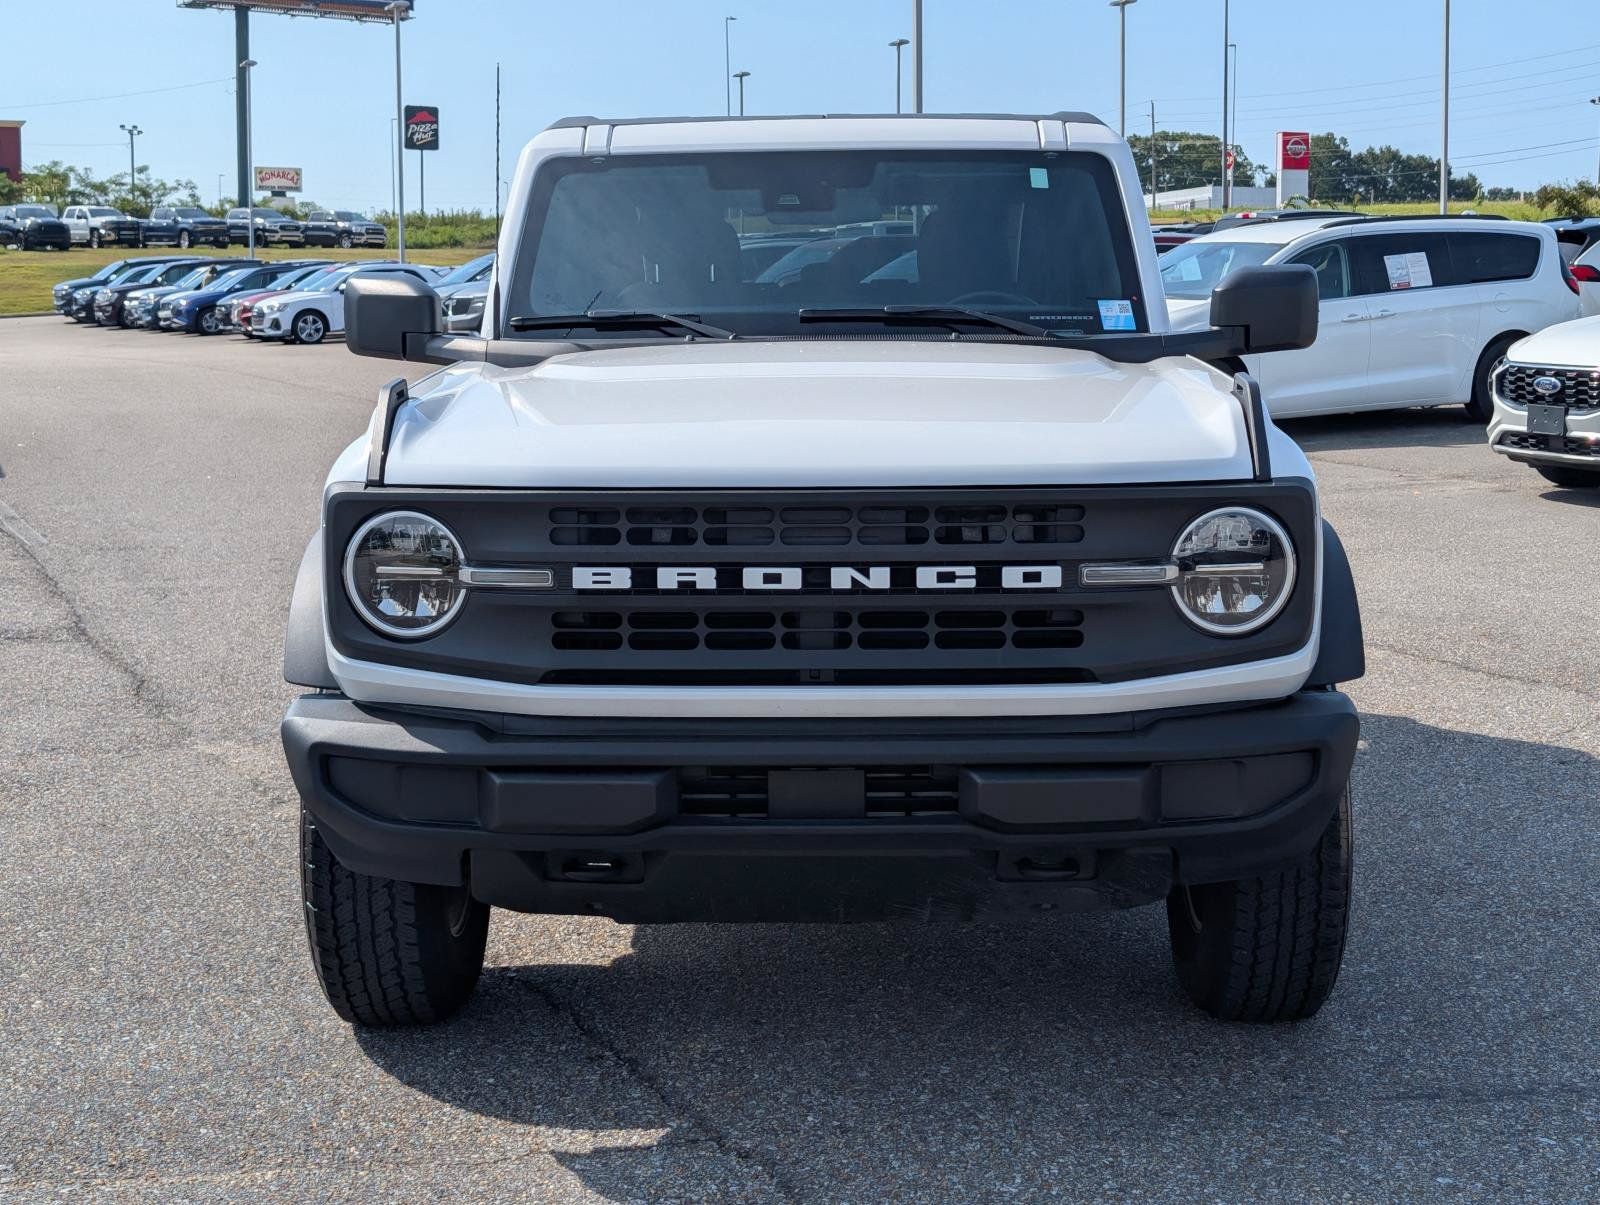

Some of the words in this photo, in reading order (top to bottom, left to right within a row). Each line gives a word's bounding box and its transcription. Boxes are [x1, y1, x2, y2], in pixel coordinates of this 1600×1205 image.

[408, 123, 438, 138] Pizza
[413, 131, 436, 142] Hut
[571, 565, 1063, 590] BRONCO
